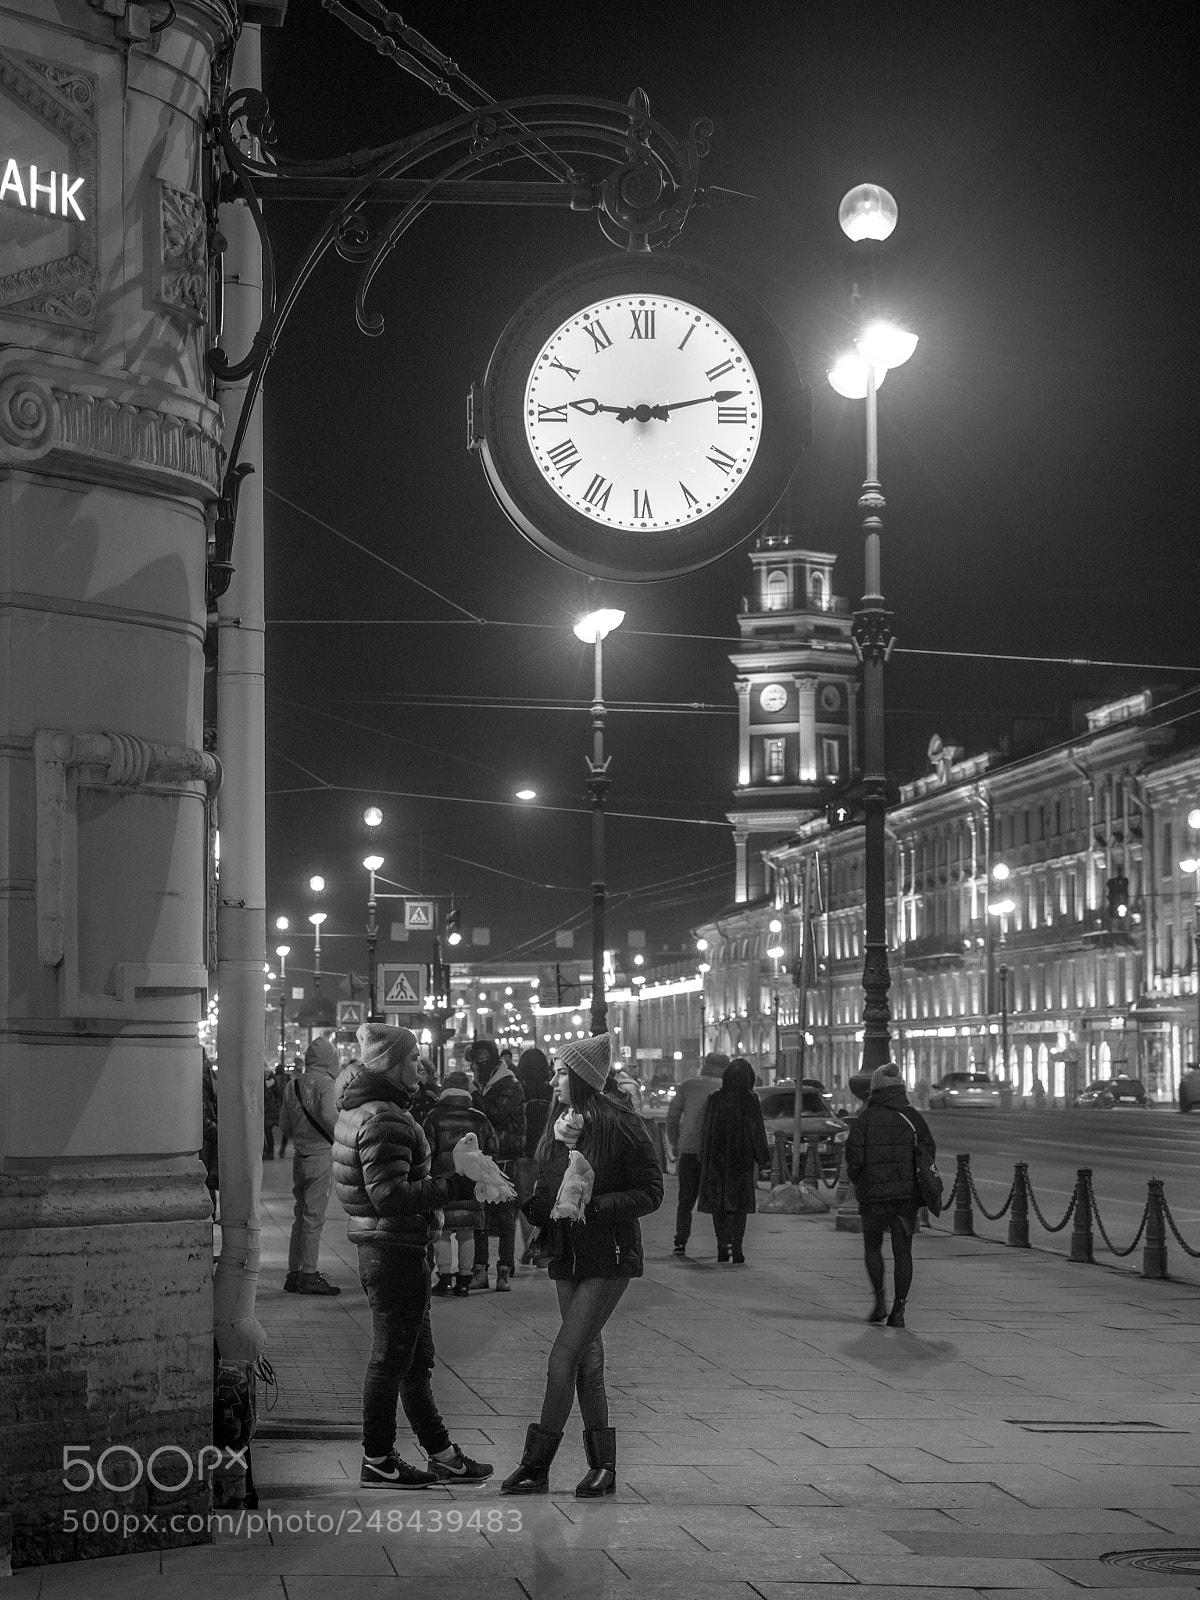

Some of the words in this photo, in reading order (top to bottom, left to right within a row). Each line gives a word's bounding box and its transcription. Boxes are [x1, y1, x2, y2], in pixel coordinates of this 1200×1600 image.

[0, 158, 86, 221] АНК
[582, 319, 614, 354] XI
[629, 309, 656, 339] XII
[677, 324, 697, 351] I
[549, 356, 580, 382] X
[705, 358, 736, 382] II
[538, 403, 568, 423] IX
[718, 406, 748, 424] III
[547, 438, 583, 479] VIII
[706, 444, 738, 475] IV
[582, 473, 613, 511] VII
[633, 489, 654, 518] VI
[679, 480, 700, 509] V
